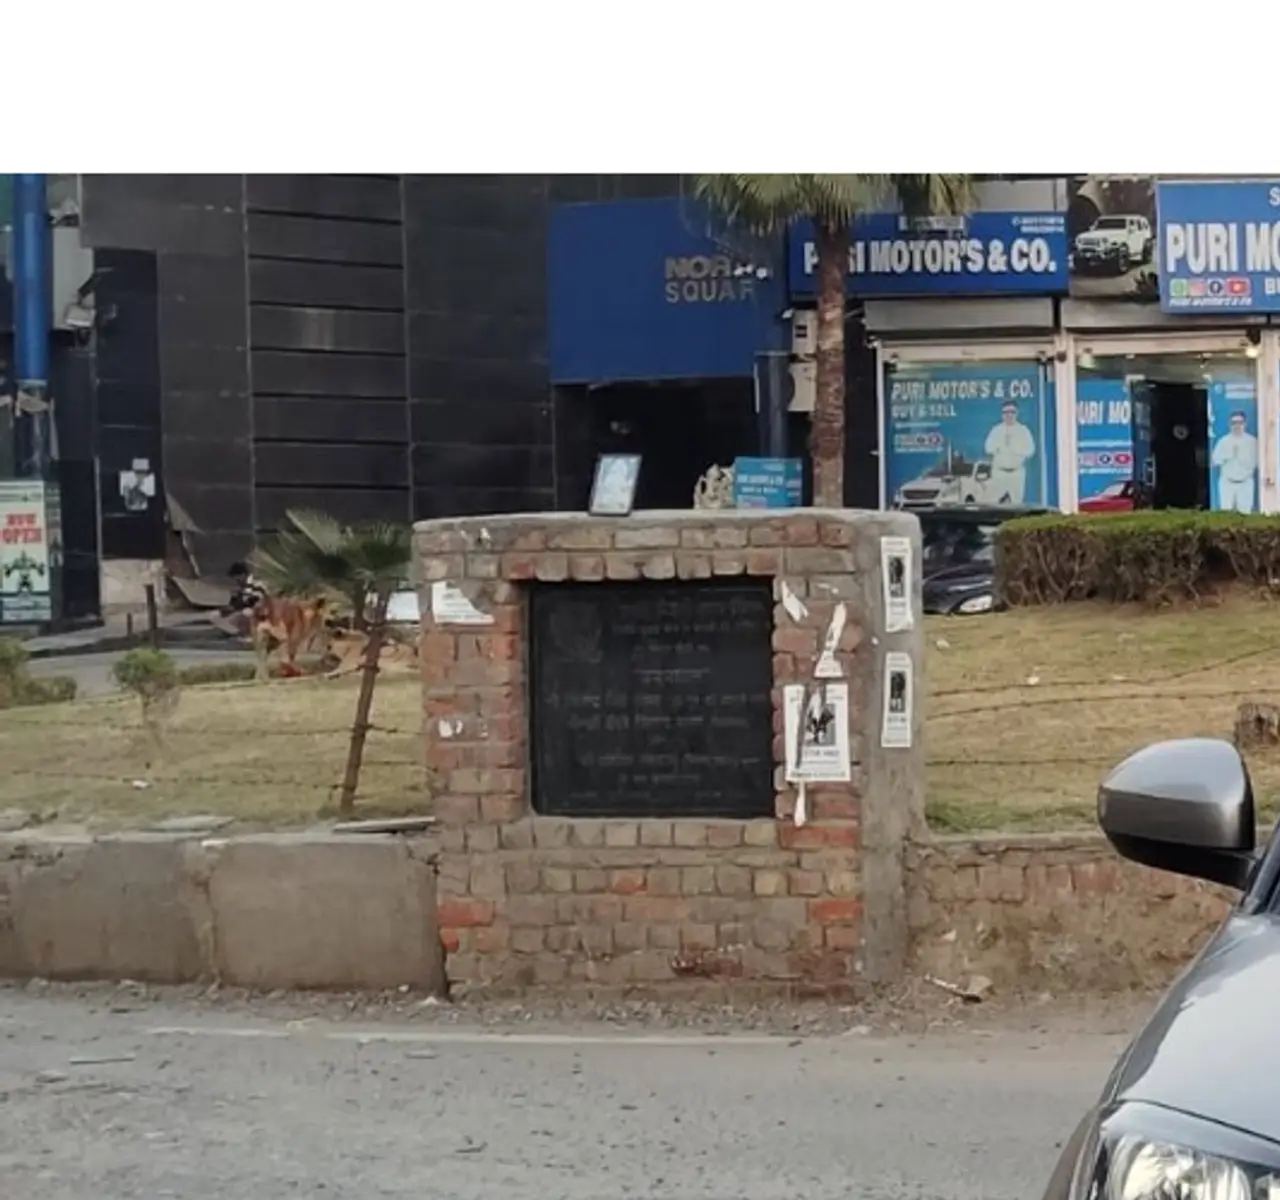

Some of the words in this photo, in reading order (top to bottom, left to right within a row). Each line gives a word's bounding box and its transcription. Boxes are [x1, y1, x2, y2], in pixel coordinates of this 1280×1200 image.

[870, 239, 983, 274] MOTOR'S
[987, 239, 1007, 273] &
[1011, 237, 1058, 273] CO.
[1166, 223, 1239, 273] PURI
